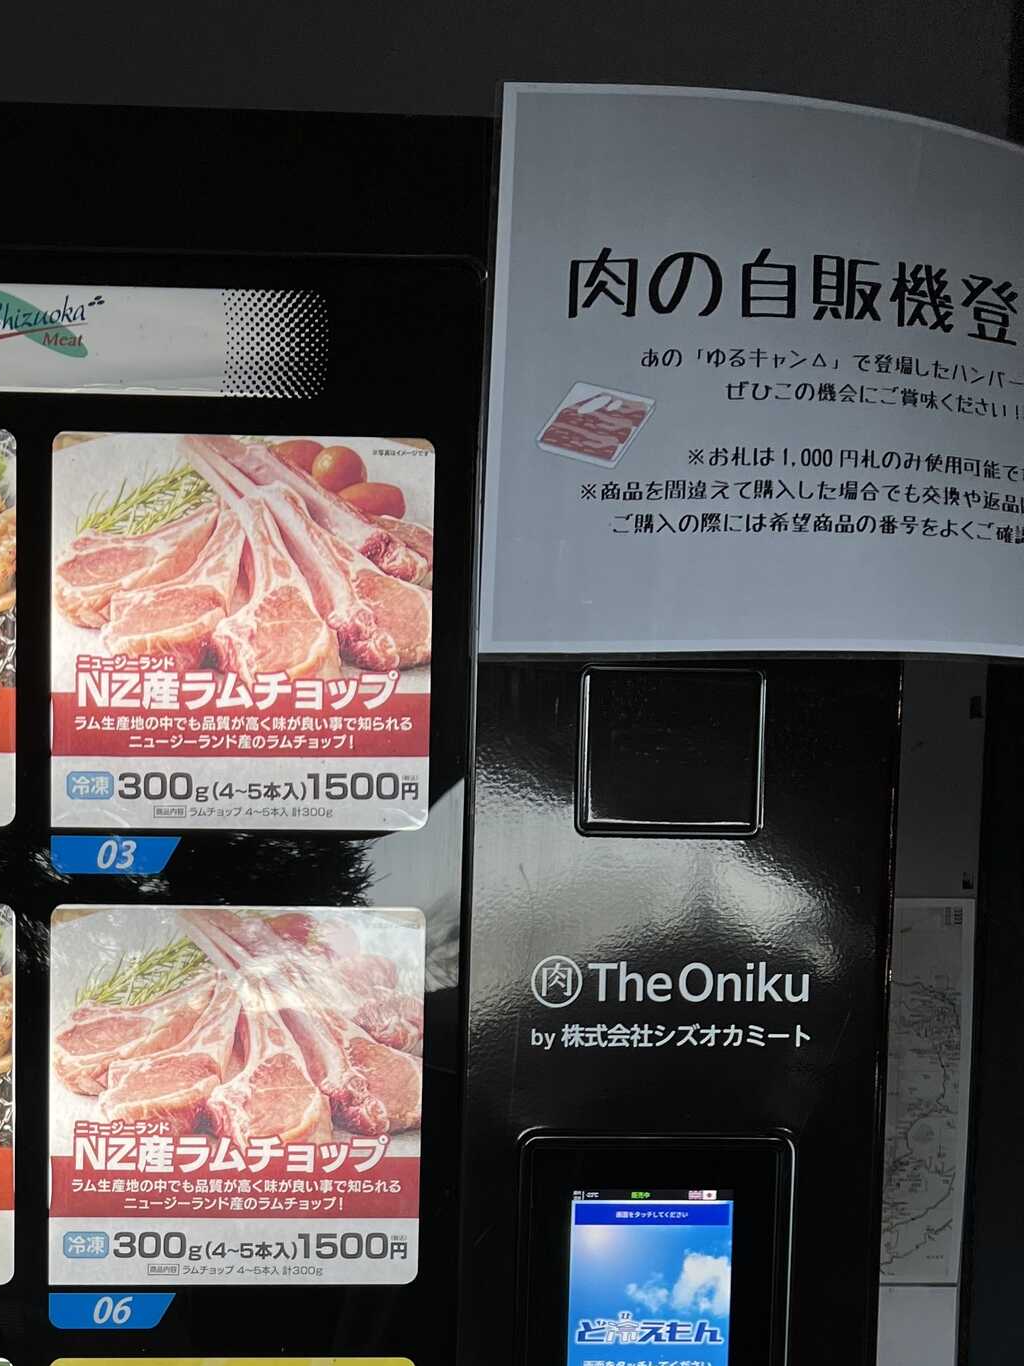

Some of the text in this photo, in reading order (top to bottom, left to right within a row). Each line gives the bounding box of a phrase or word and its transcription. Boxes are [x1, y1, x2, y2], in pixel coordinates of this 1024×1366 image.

[568, 248, 1021, 346] 肉の自販機登
[44, 332, 82, 346] Meat
[726, 382, 1024, 420] ぜひこの機会にご賞味ください!
[688, 448, 1024, 483] ※お札は1,000円札のみ使用可能で
[580, 480, 1024, 514] ※商品を間違えて購入した場合でも交換や返品
[78, 656, 174, 670] ニュージーランド
[78, 671, 399, 710] NZ産ラムチョップ
[74, 715, 412, 731] ラム生産地の中でも品質が高く味が良い事で知られる
[129, 734, 354, 750] ニュージーランド産のラムチョップ!
[71, 775, 109, 795] 冷凍
[189, 807, 242, 817] ラムチョップ
[97, 841, 135, 869] 03
[531, 1024, 810, 1049] by 株式会社シズオカミート
[76, 1122, 170, 1135] ニュージーランド
[74, 1137, 388, 1173] NZ産ラムチョップ
[71, 1179, 401, 1194] ラム生産地の中でも品質が高く味が良い事で知られる
[124, 1198, 343, 1211] ニュージーランド産のラムチョップ!
[68, 1236, 105, 1255] 冷凍
[182, 1265, 234, 1275] ラムチョップ
[93, 1297, 132, 1324] 06
